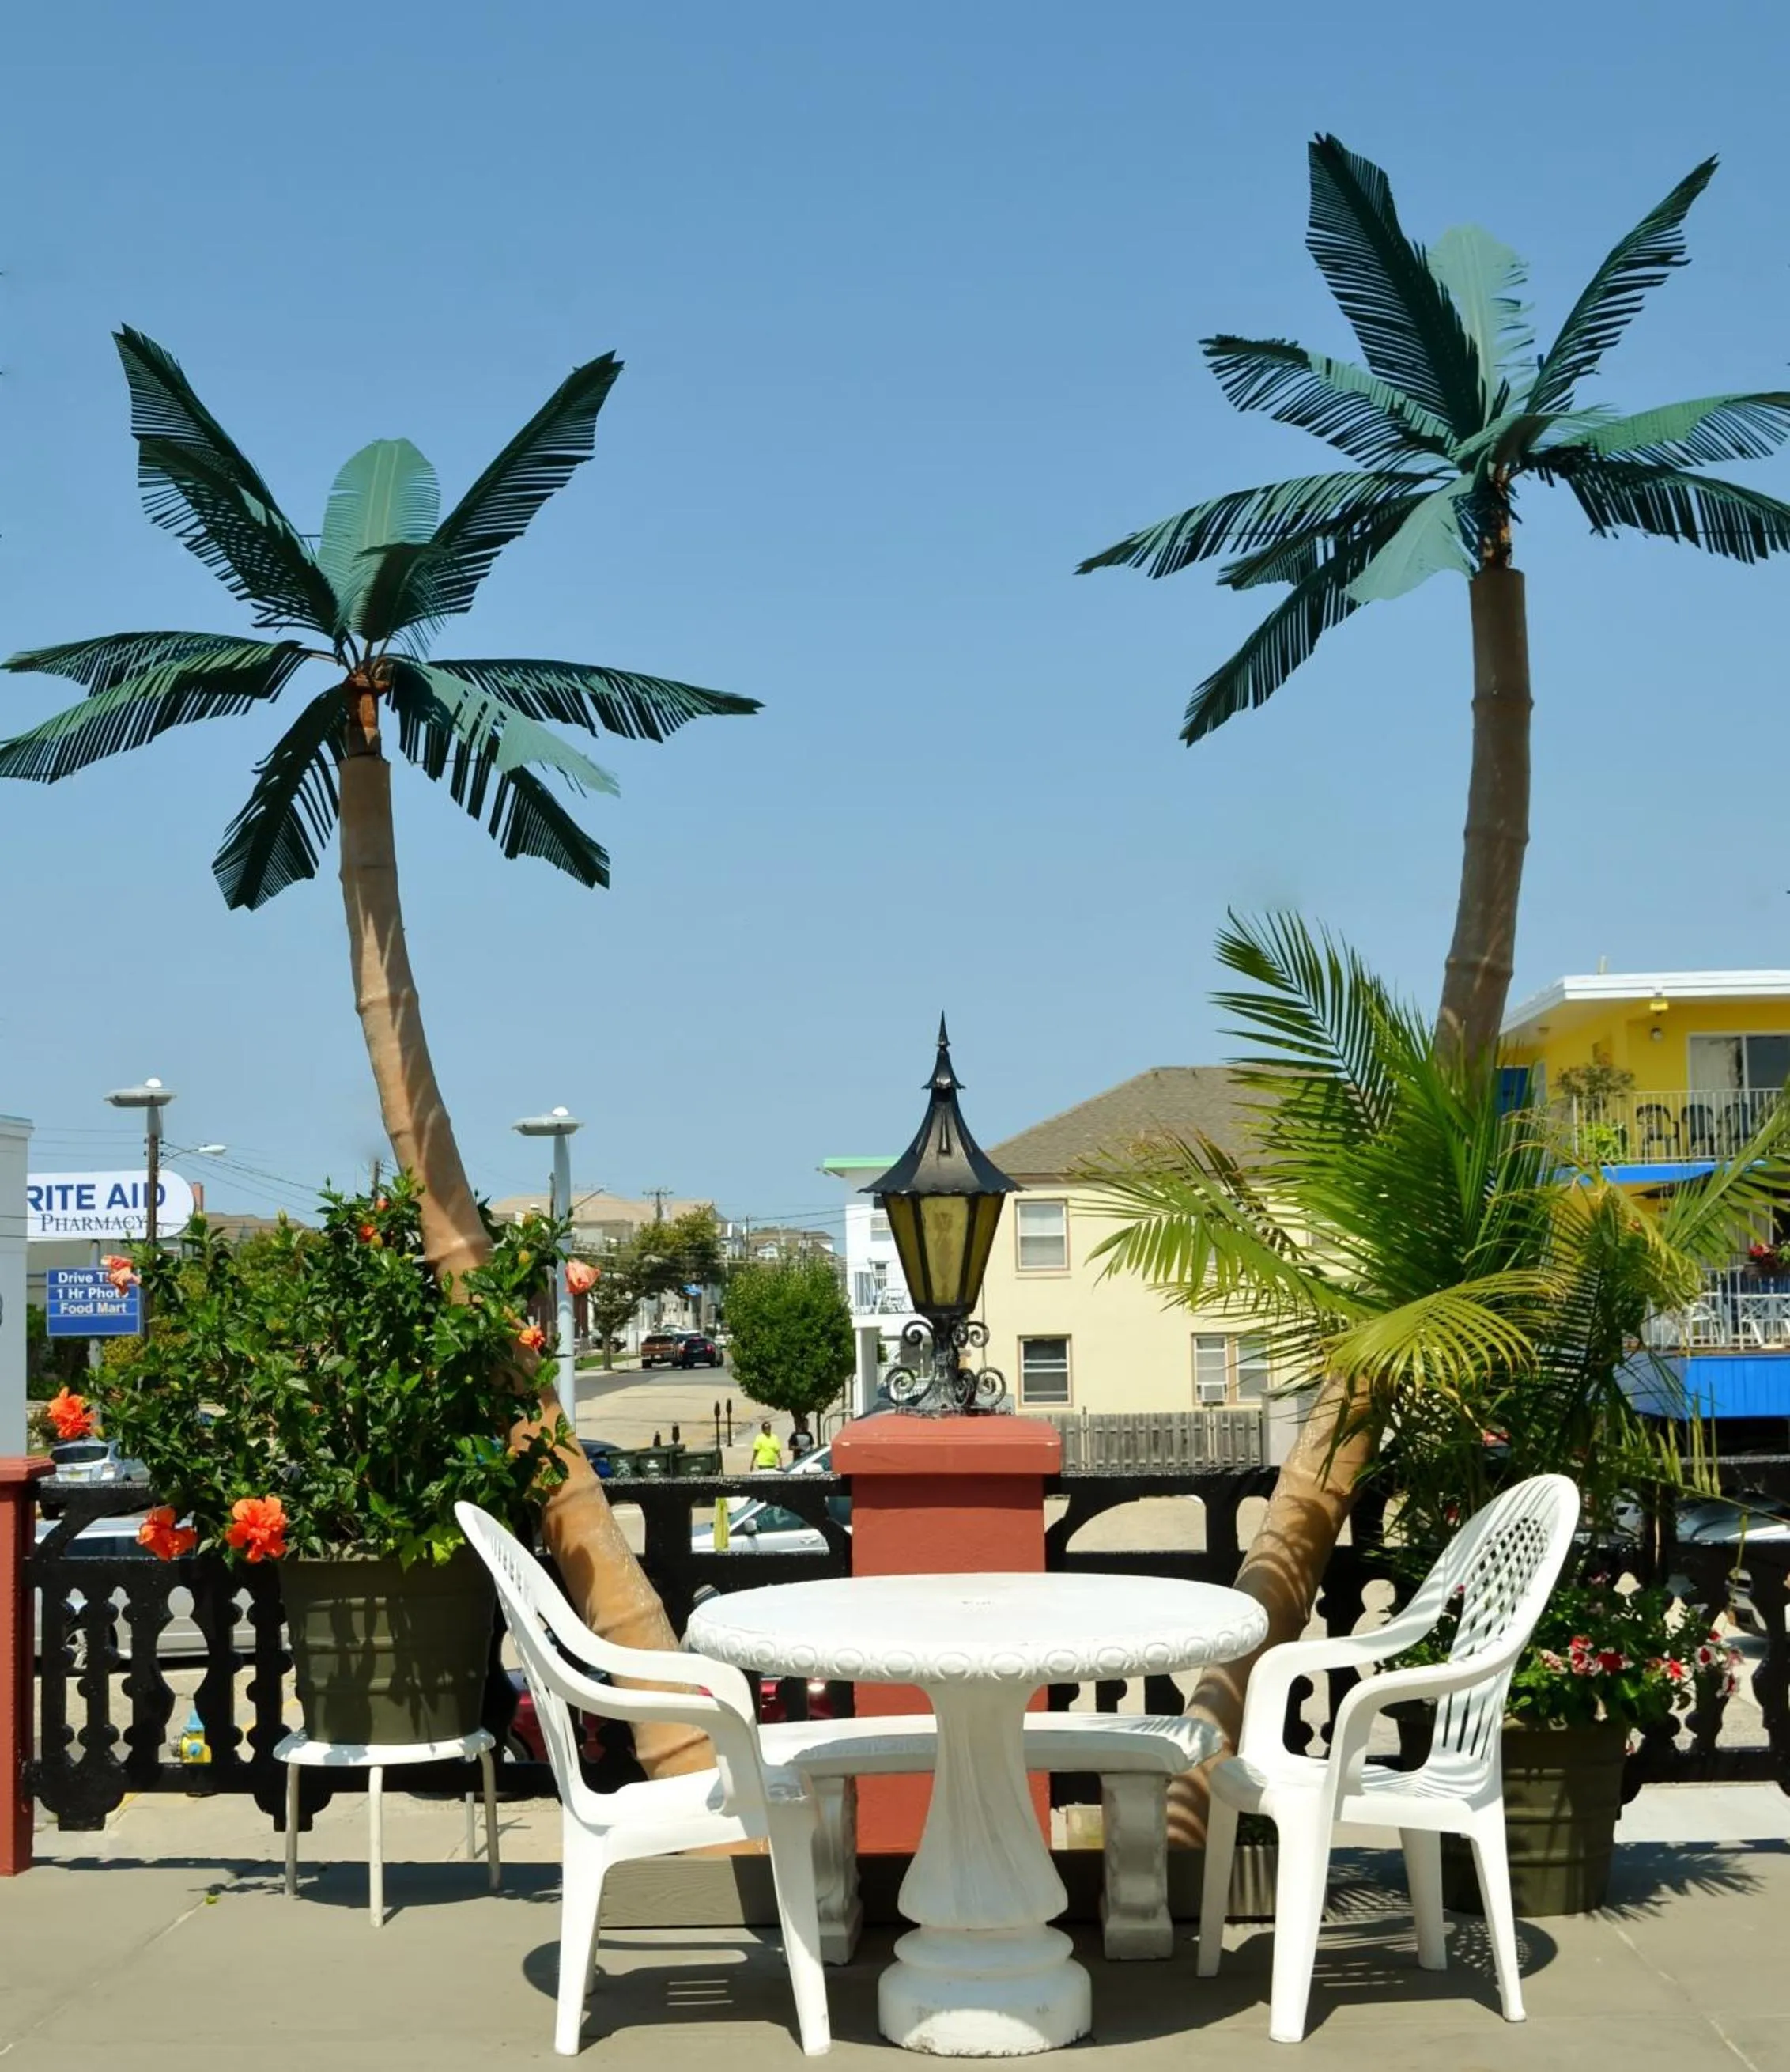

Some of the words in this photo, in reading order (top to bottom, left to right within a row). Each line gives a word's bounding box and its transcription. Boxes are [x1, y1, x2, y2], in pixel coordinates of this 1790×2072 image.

[27, 1184, 96, 1211] RITE
[107, 1182, 166, 1209] AID
[41, 1214, 148, 1231] PHARMACY
[58, 1272, 93, 1284] Drive
[57, 1288, 63, 1299] 1
[68, 1287, 84, 1299] Hr
[88, 1287, 129, 1299] Phot
[60, 1303, 93, 1314] Food
[97, 1302, 127, 1313] Mart
